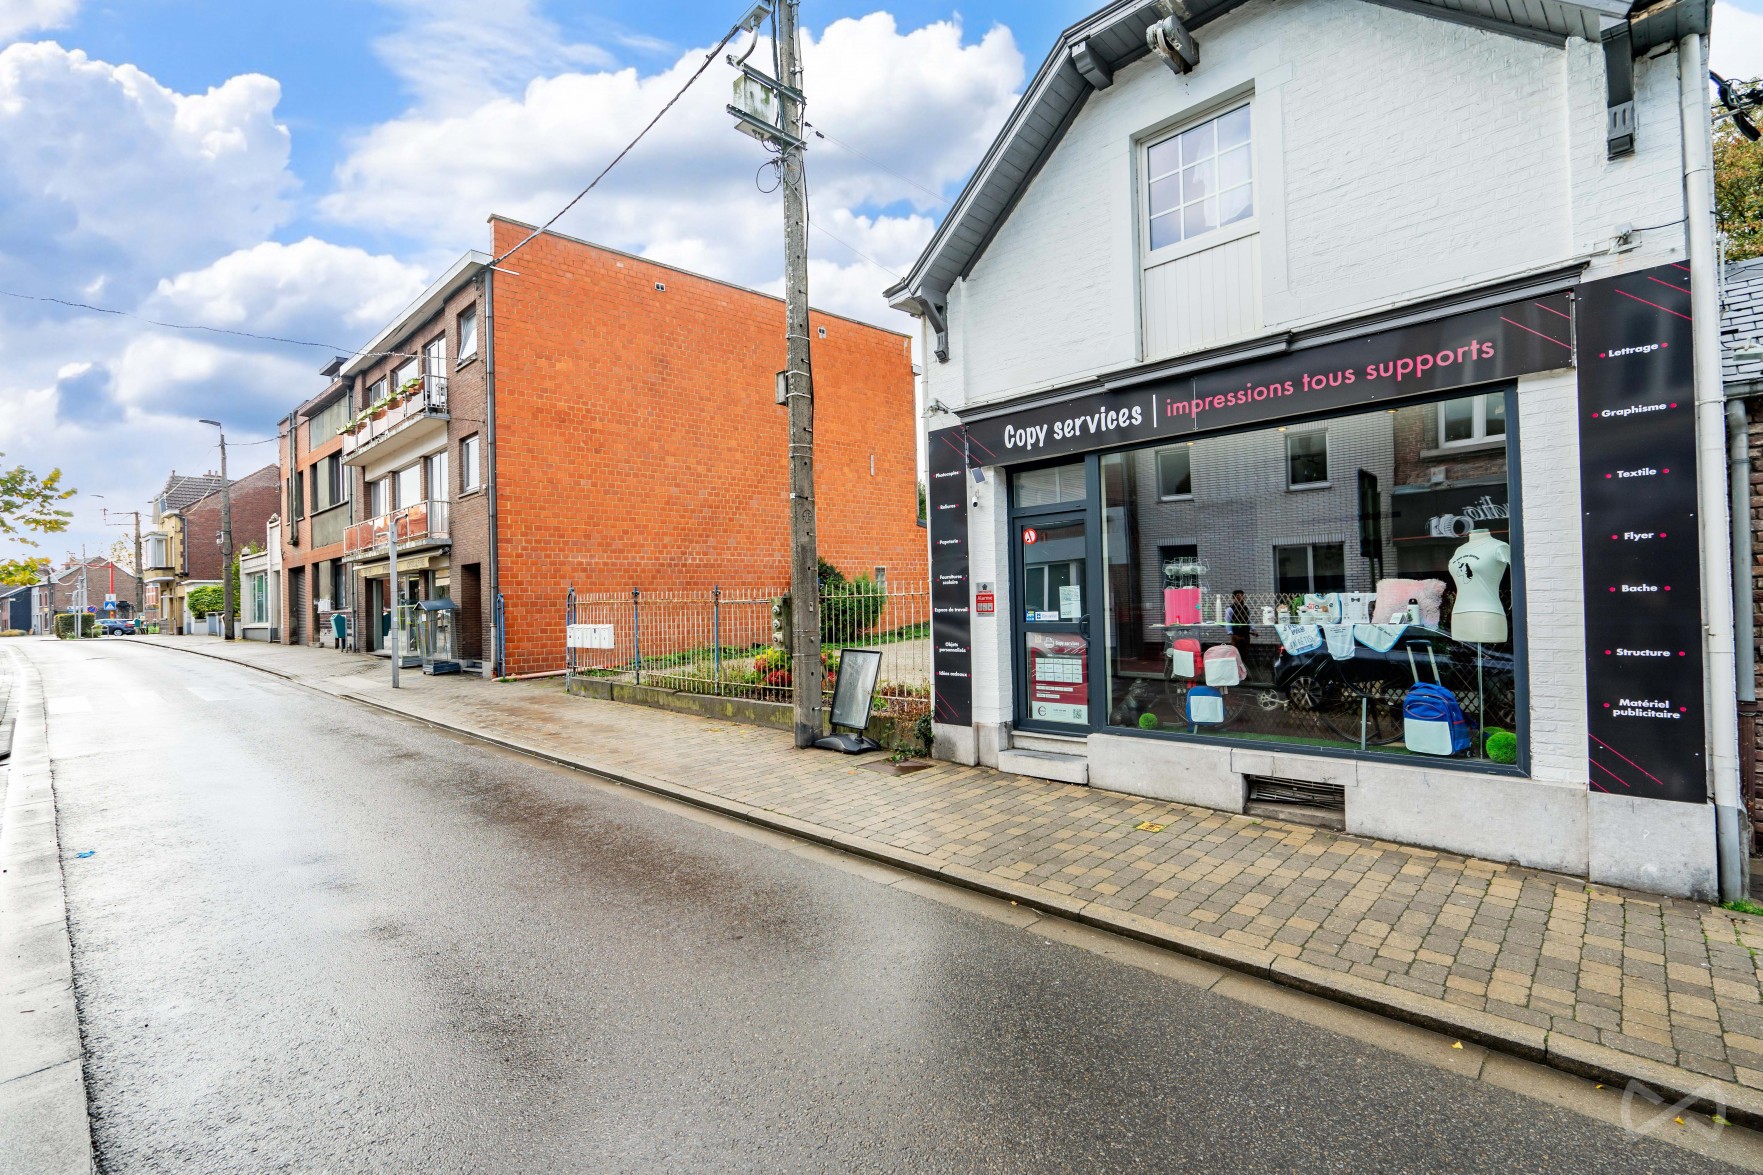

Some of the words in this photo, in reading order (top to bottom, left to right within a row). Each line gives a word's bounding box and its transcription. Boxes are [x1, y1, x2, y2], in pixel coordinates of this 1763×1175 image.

[1608, 342, 1659, 358] Lettrage
[1004, 424, 1047, 450] Copy
[1053, 406, 1142, 440] services
[1166, 378, 1293, 418] impressions
[1302, 367, 1355, 392] tous
[1366, 339, 1495, 381] supports
[1601, 402, 1667, 418] Graphisme
[1616, 468, 1657, 478] Textile
[1623, 531, 1655, 542] Flyer
[1621, 583, 1658, 592] Bache
[1616, 648, 1671, 657] Structure
[1619, 698, 1670, 709] Matériel
[1613, 707, 1681, 719] publicitaire
